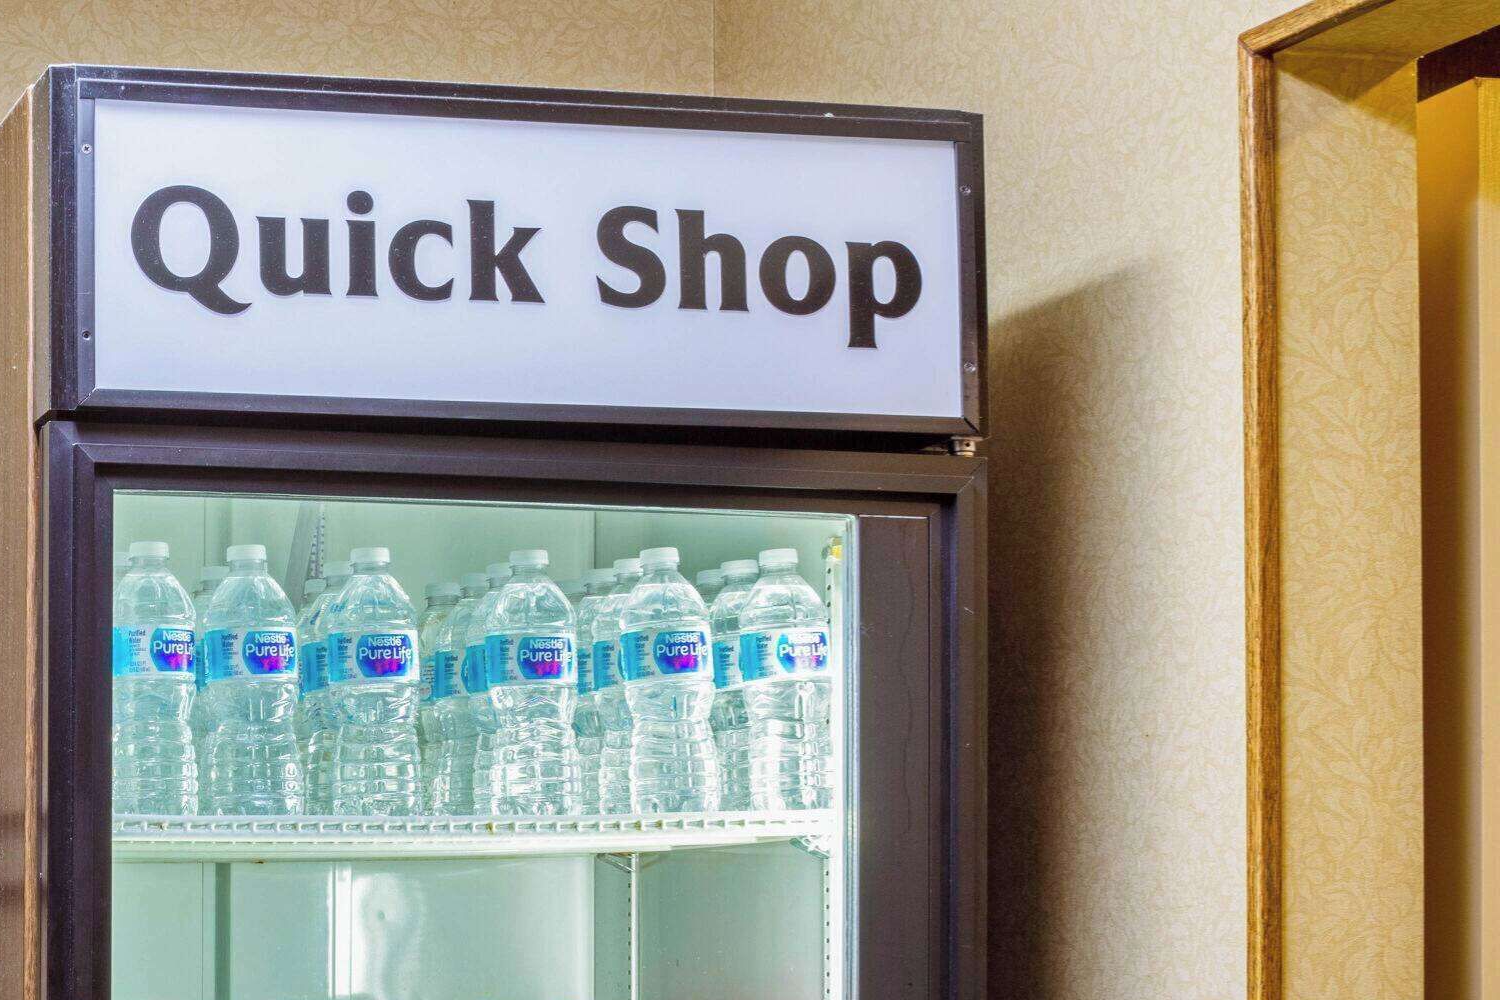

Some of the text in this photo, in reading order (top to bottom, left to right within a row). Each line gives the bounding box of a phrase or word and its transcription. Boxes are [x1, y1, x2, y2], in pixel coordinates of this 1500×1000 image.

[130, 184, 923, 349] Quick Shop
[153, 641, 183, 655] Pure
[245, 644, 278, 657] Pure
[359, 648, 392, 660] Pure
[656, 644, 688, 657] Pure
[779, 644, 810, 657] Pure
[520, 650, 552, 662] Pure
